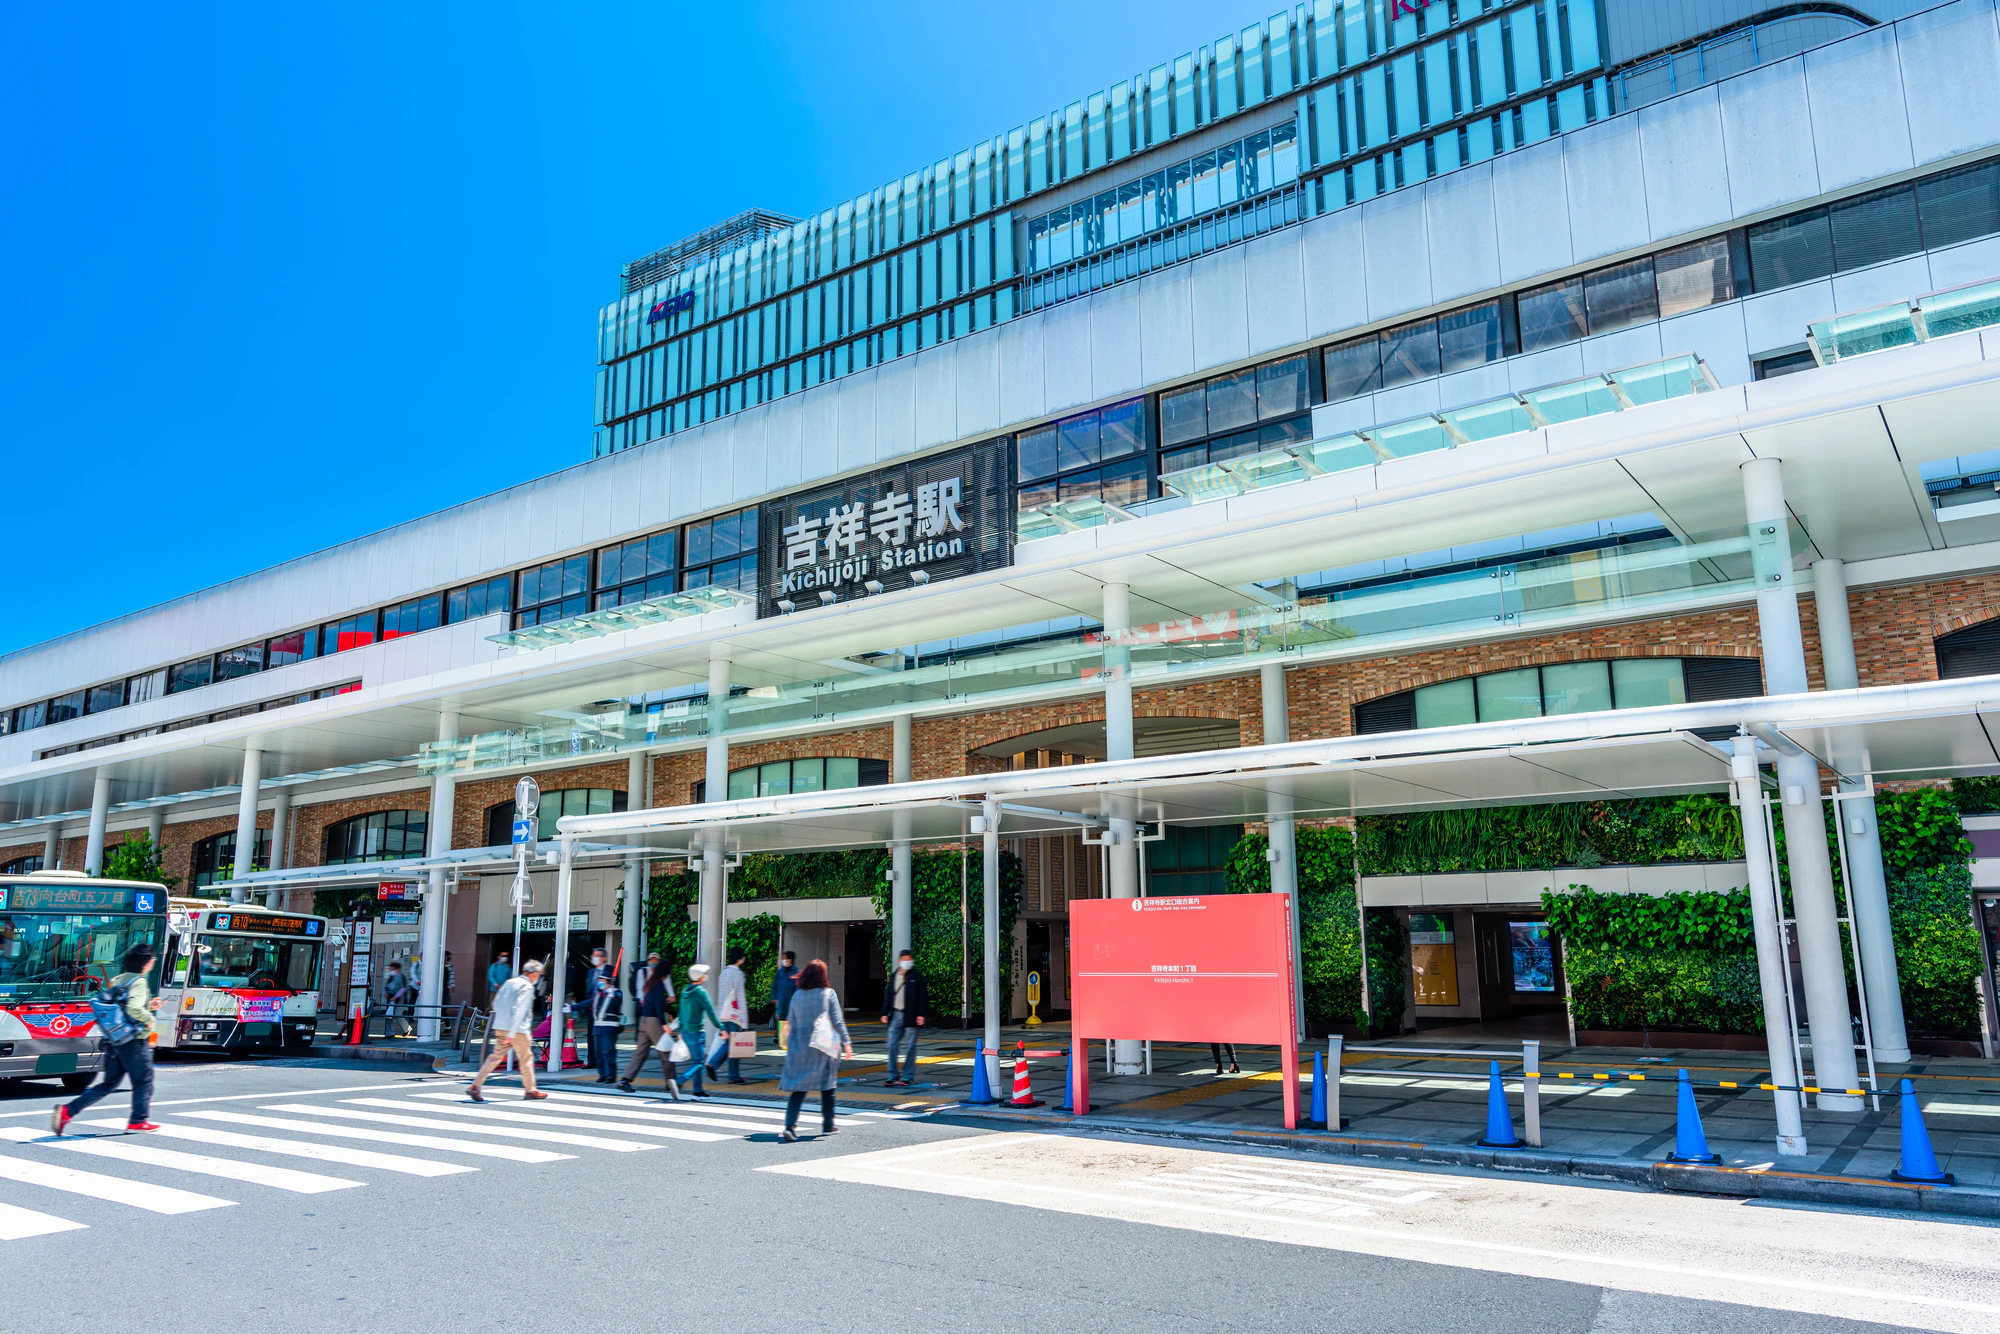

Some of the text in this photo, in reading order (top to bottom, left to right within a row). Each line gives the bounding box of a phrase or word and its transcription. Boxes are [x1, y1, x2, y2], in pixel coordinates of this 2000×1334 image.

[646, 290, 695, 325] KEIO
[783, 477, 964, 571] 吉祥寺駅
[782, 537, 965, 594] Kichijōji Station
[40, 889, 125, 904] 向台町五丁目
[381, 886, 388, 895] 3
[1144, 898, 1200, 906] 吉祥寺駅北口総合案内
[529, 918, 556, 929] 吉祥寺駅
[359, 926, 367, 935] 3
